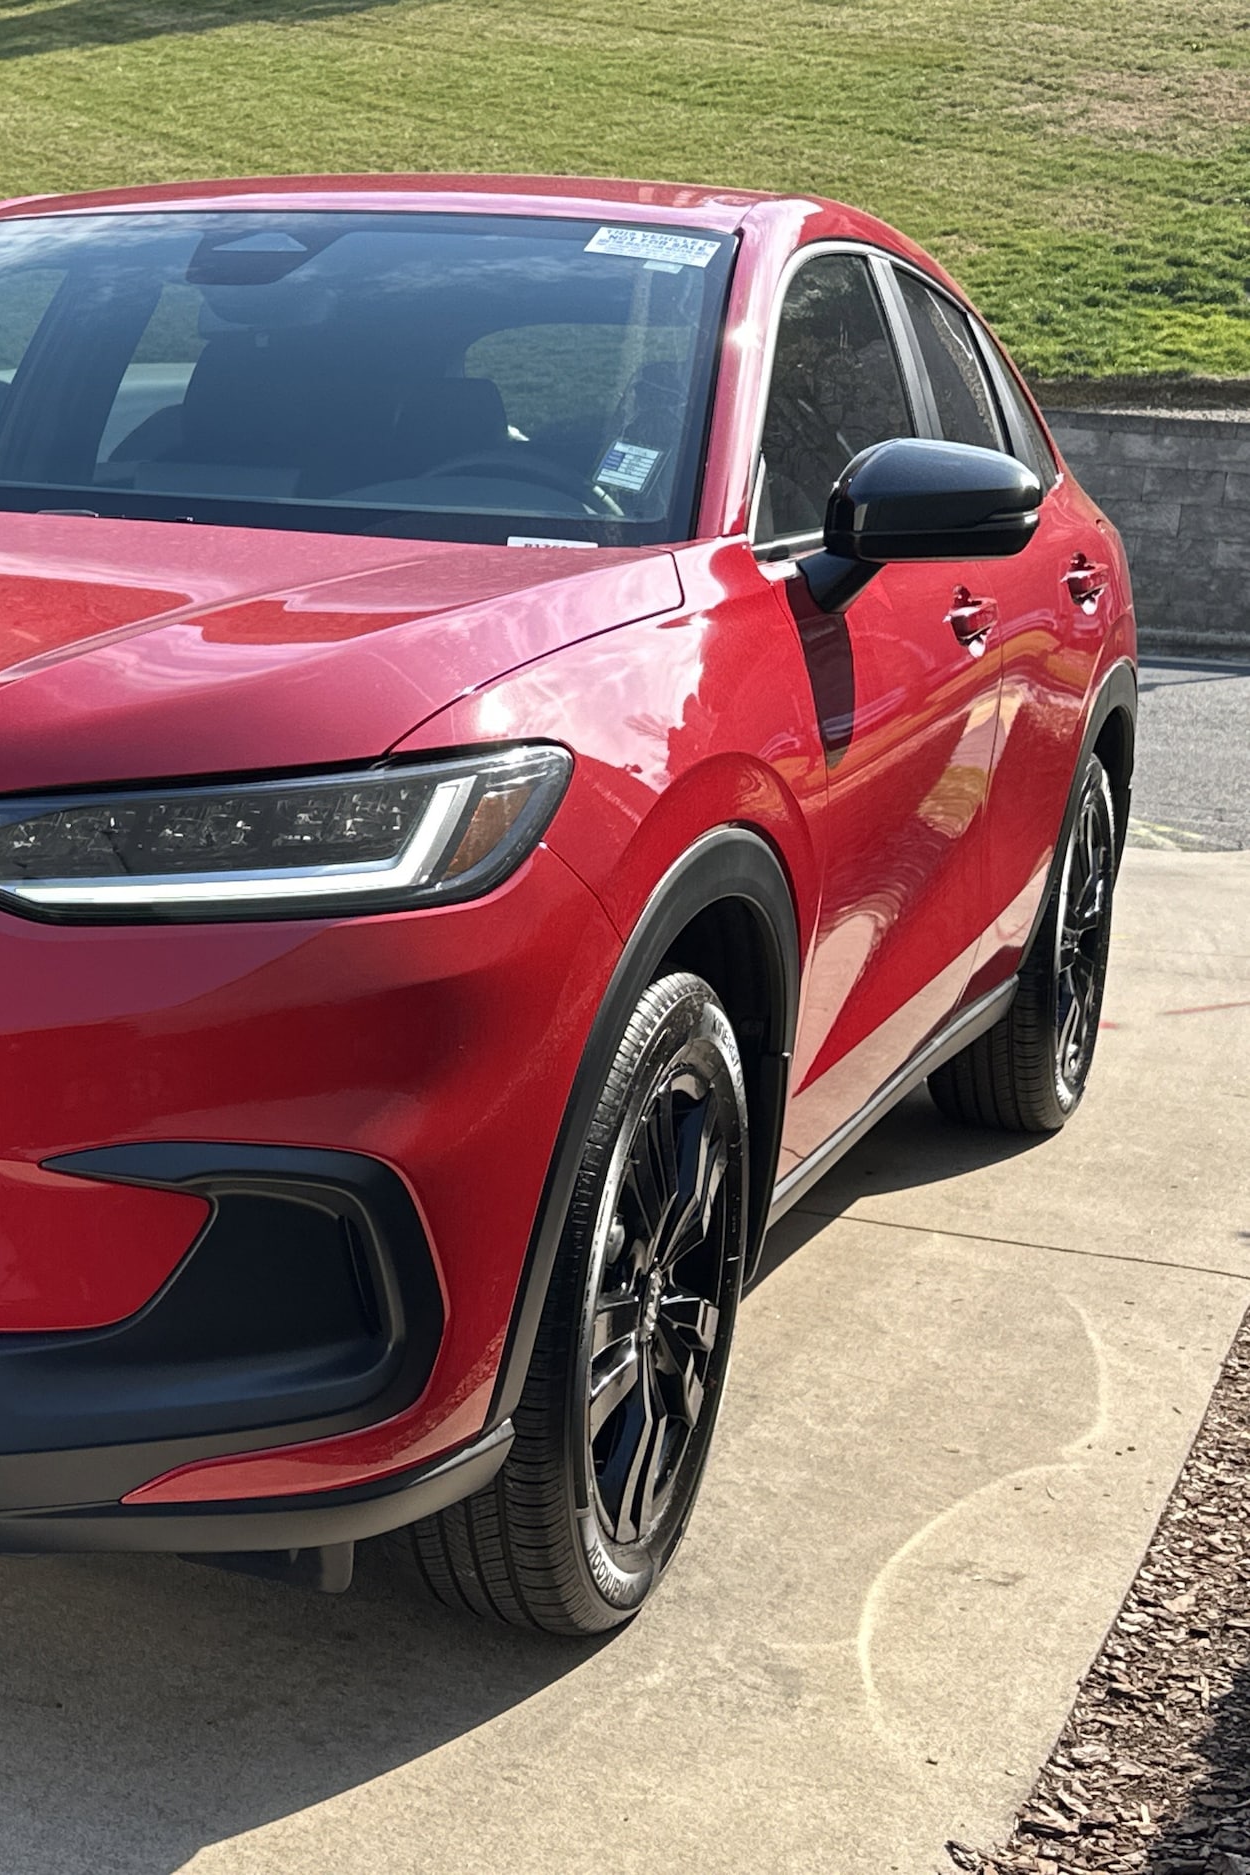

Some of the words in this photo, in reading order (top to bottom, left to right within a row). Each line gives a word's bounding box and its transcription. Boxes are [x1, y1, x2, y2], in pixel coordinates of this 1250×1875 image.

[607, 229, 636, 237] THIS
[642, 233, 699, 245] VEHICLE
[609, 234, 637, 242] NOT
[640, 238, 668, 246] FOR
[672, 242, 706, 252] SALE
